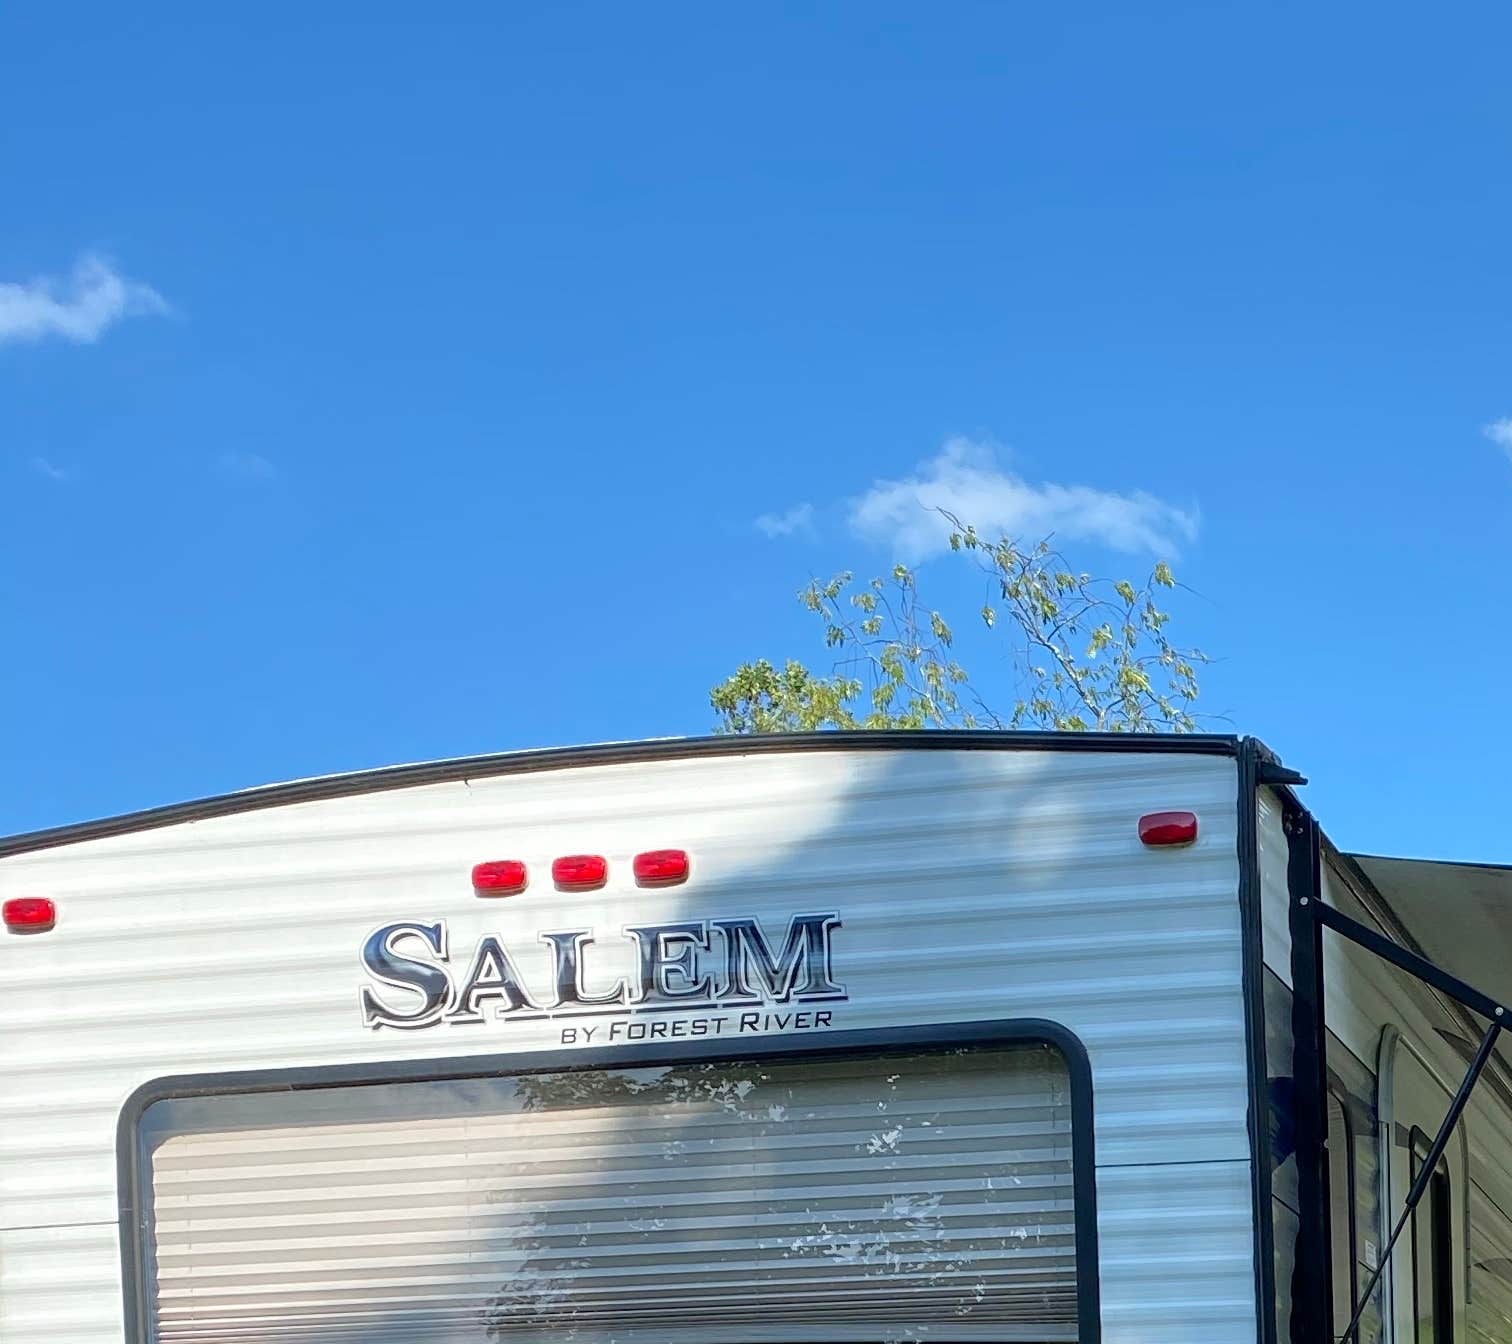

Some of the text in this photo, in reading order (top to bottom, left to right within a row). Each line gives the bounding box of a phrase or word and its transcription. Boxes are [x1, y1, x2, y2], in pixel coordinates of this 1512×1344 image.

[360, 909, 849, 1030] SALEM
[560, 1010, 833, 1044] BY FOREST RIVER
